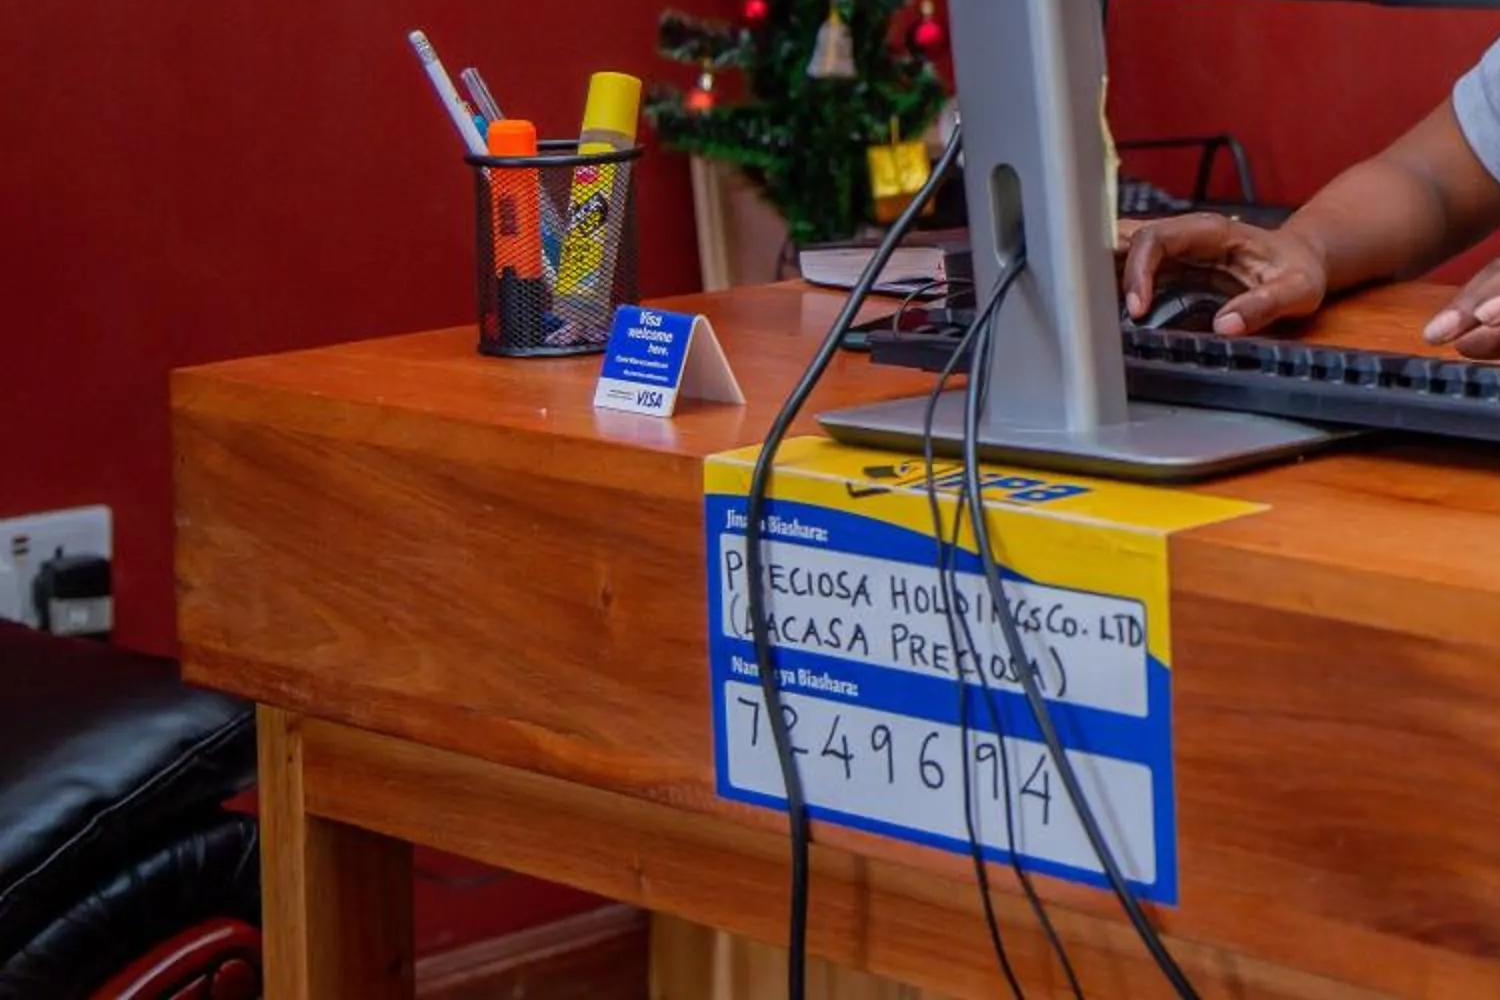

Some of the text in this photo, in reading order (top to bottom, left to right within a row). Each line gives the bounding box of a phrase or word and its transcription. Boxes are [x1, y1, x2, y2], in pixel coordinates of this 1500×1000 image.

[628, 327, 673, 343] welcome
[637, 391, 663, 408] VISA
[767, 515, 828, 542] Biashara:
[725, 550, 872, 607] PECIOSA
[1100, 613, 1144, 647] LTD
[780, 669, 795, 686] ya
[798, 668, 859, 697] Biashara:
[737, 697, 1052, 825] 7249694
